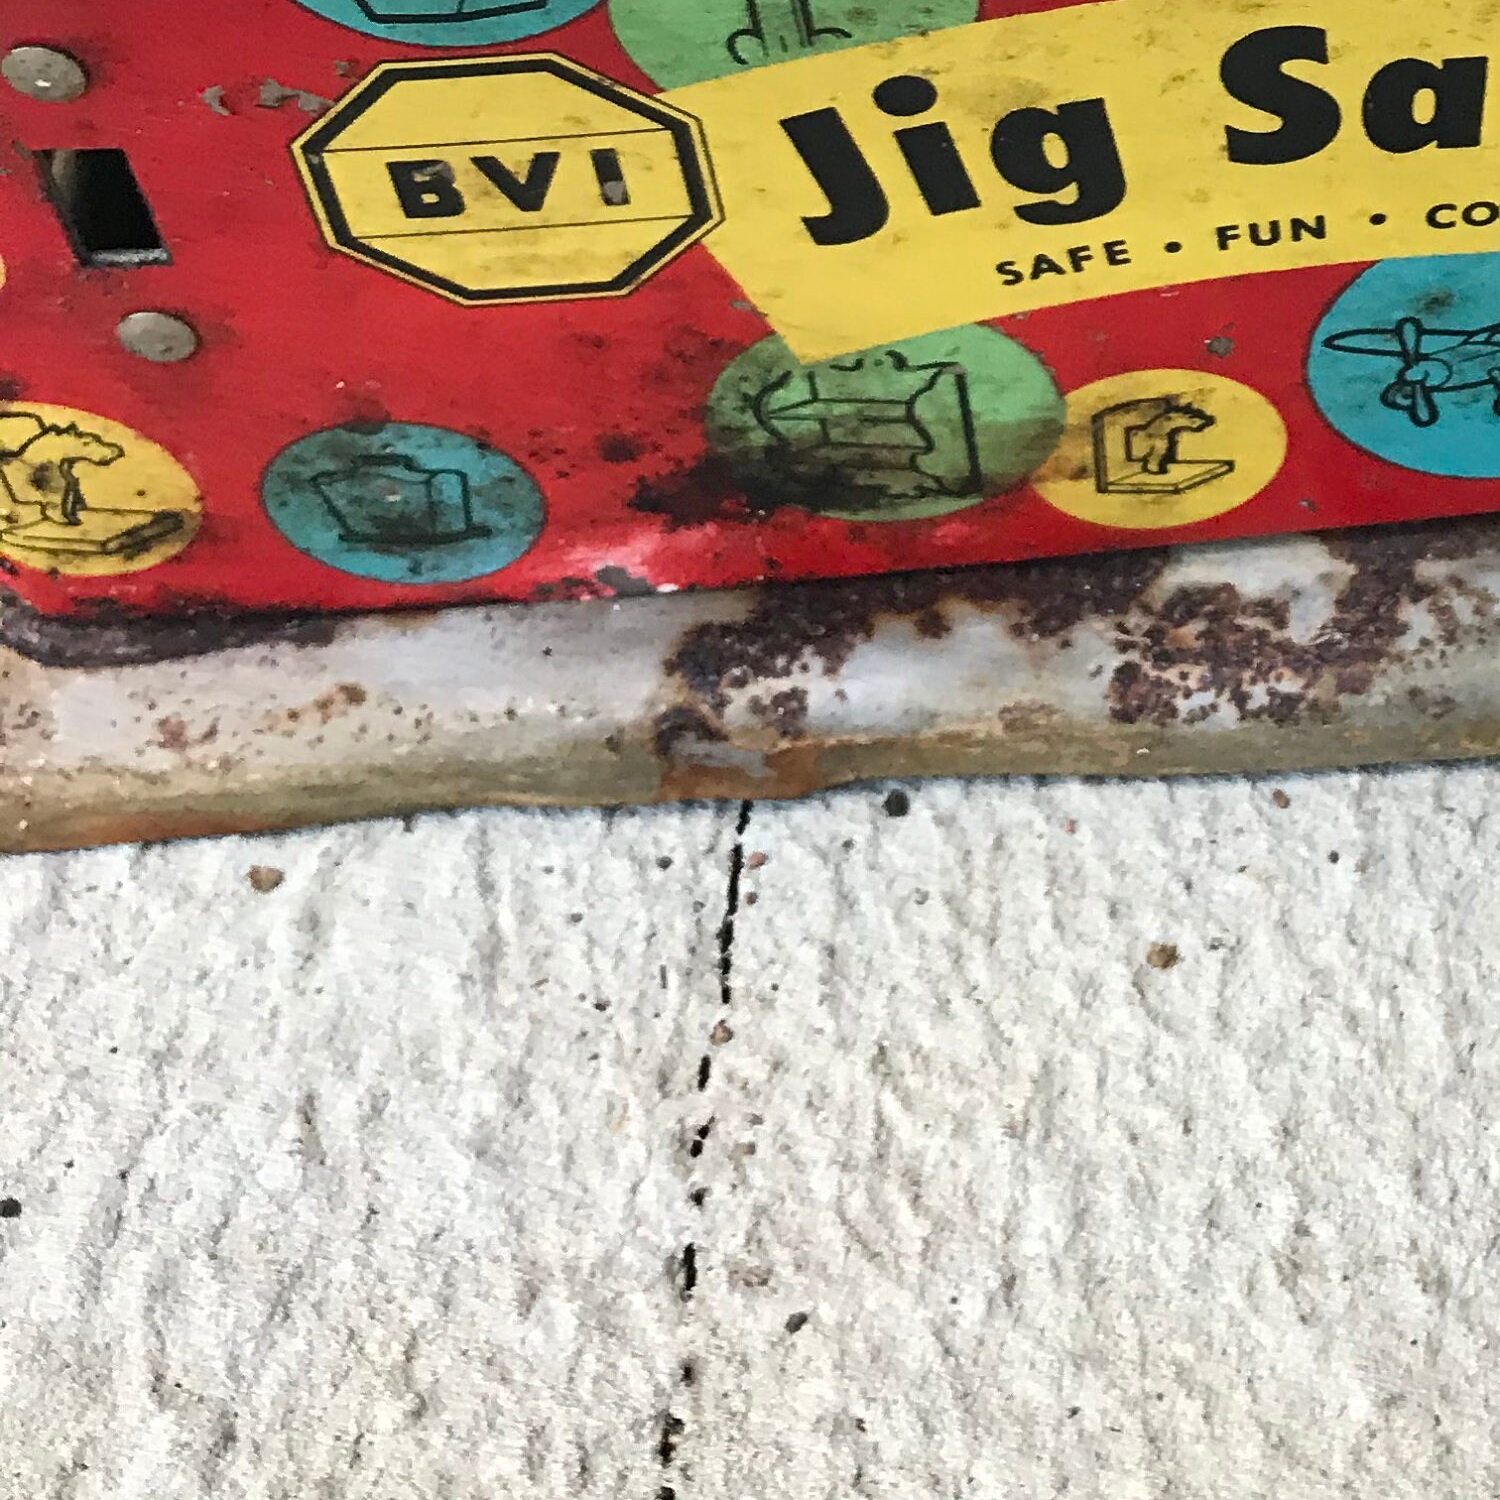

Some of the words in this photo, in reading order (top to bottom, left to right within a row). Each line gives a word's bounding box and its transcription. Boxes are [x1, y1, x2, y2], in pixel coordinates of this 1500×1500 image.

[385, 147, 632, 219] BVI
[779, 74, 1128, 246] Jig
[995, 239, 1132, 287] SAFE
[1215, 214, 1327, 252] FUN
